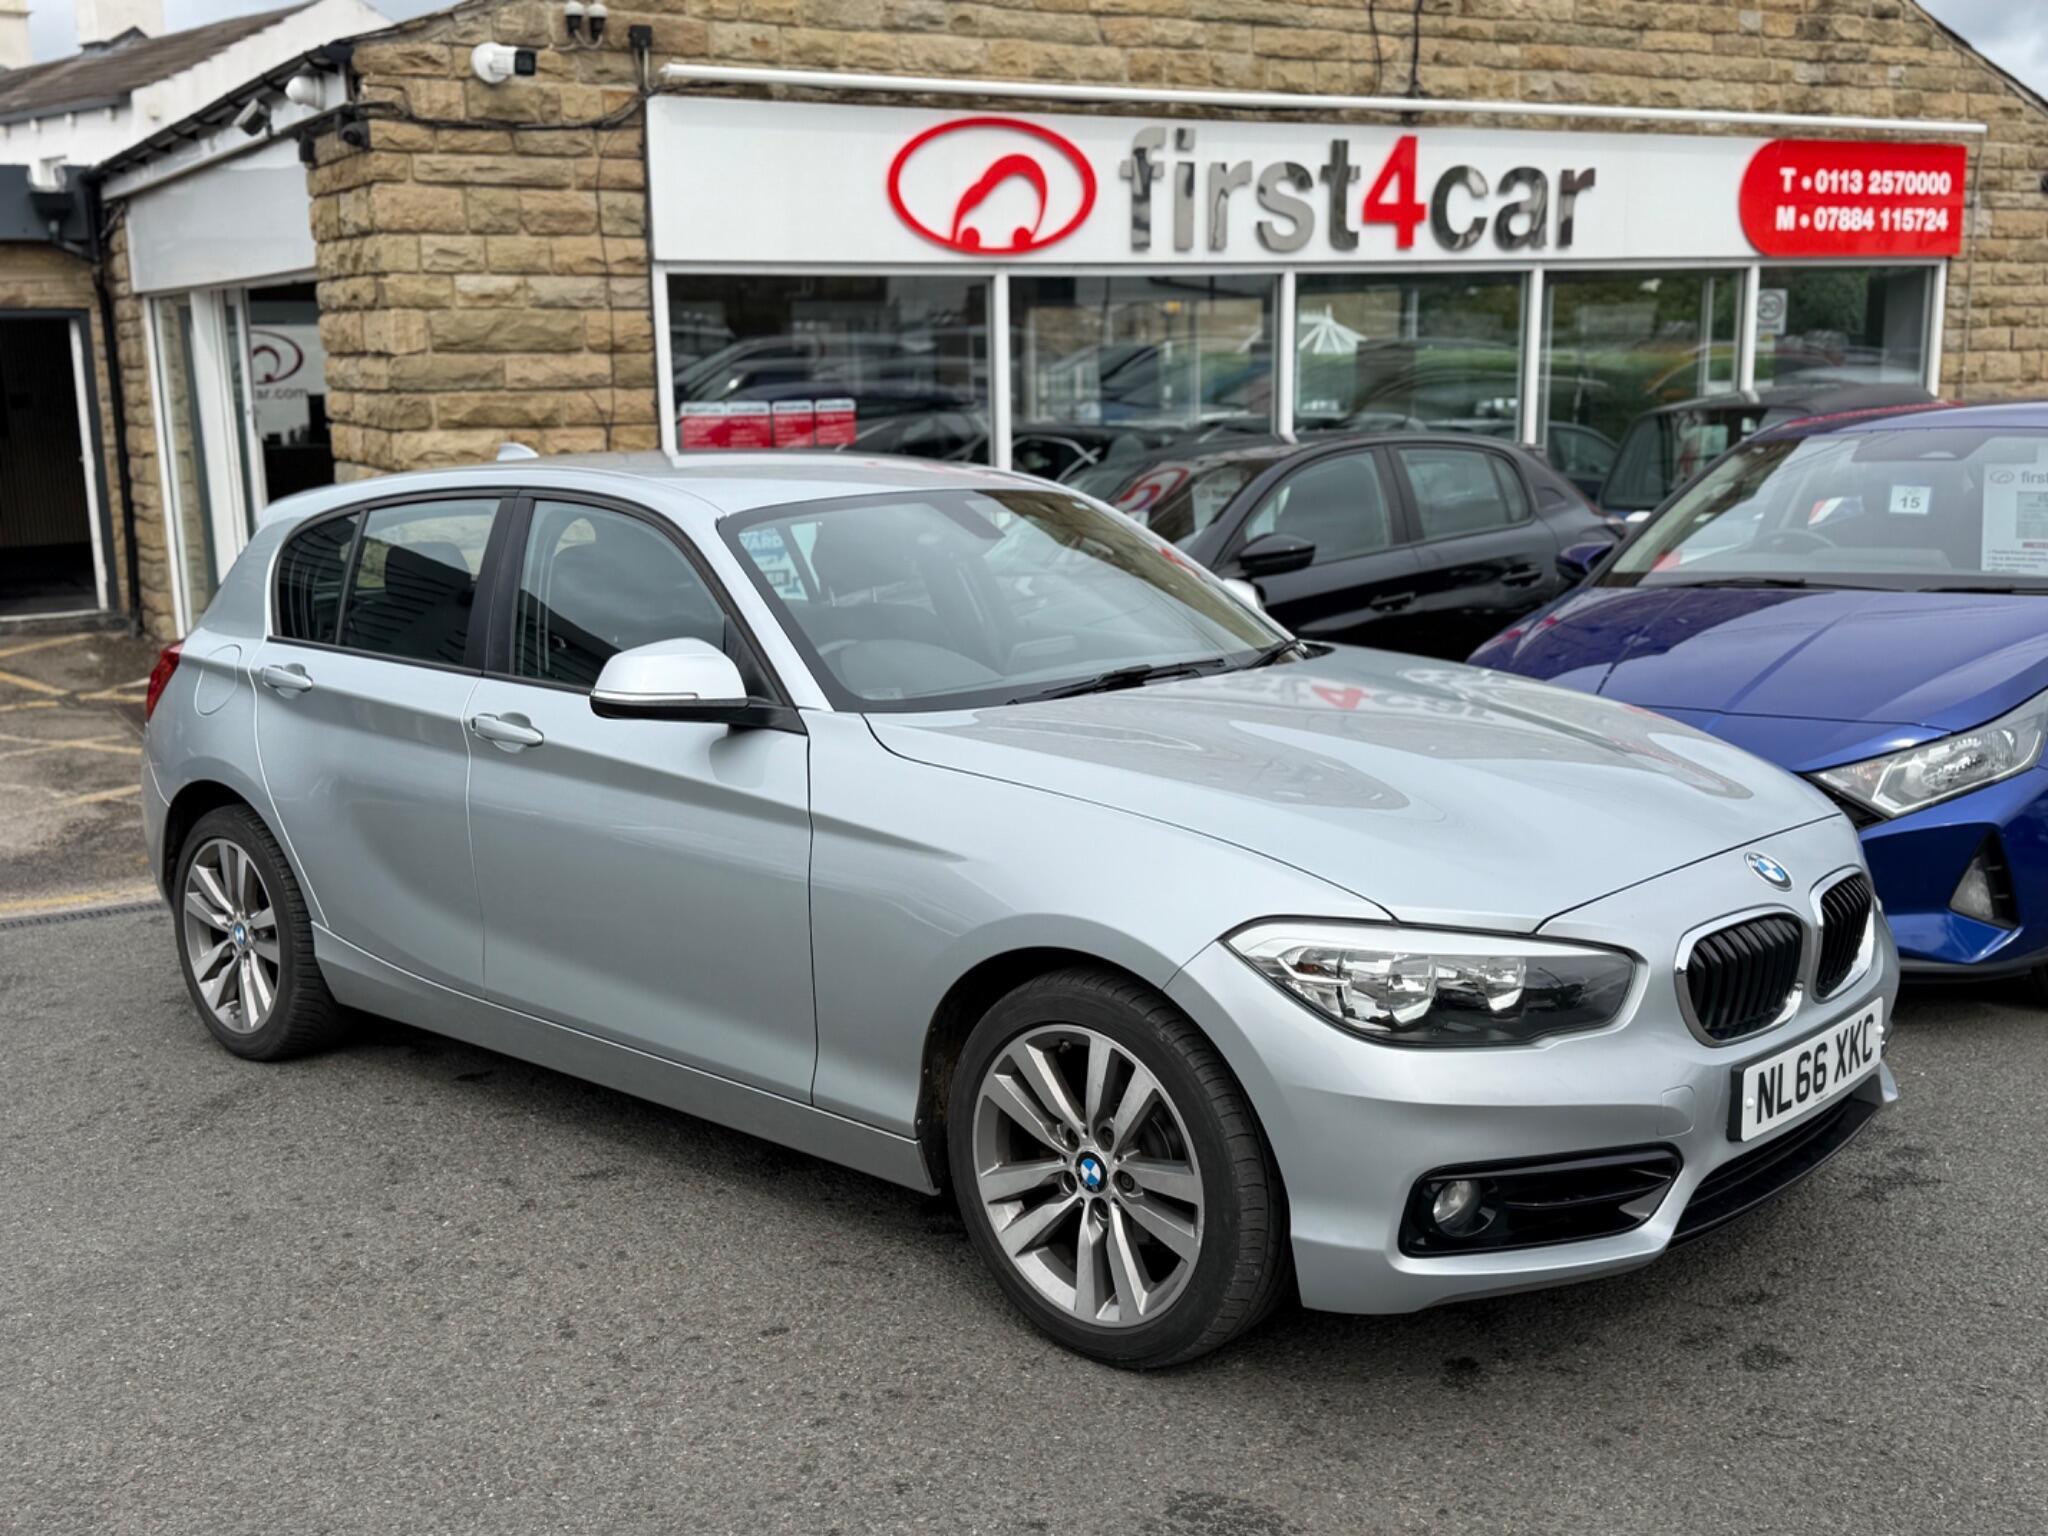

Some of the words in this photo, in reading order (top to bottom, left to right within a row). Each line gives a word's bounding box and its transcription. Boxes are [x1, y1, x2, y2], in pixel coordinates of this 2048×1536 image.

[1119, 126, 1596, 252] first4car
[1779, 167, 1797, 193] T
[1814, 168, 1863, 194] 0113
[1867, 169, 1951, 195] 2570000
[1776, 205, 1796, 231] M
[1813, 206, 1875, 231] 07884
[1880, 207, 1949, 232] 115724
[1900, 496, 1921, 509] 15
[1756, 1041, 1828, 1125] NL66
[1833, 1013, 1874, 1083] XKC
